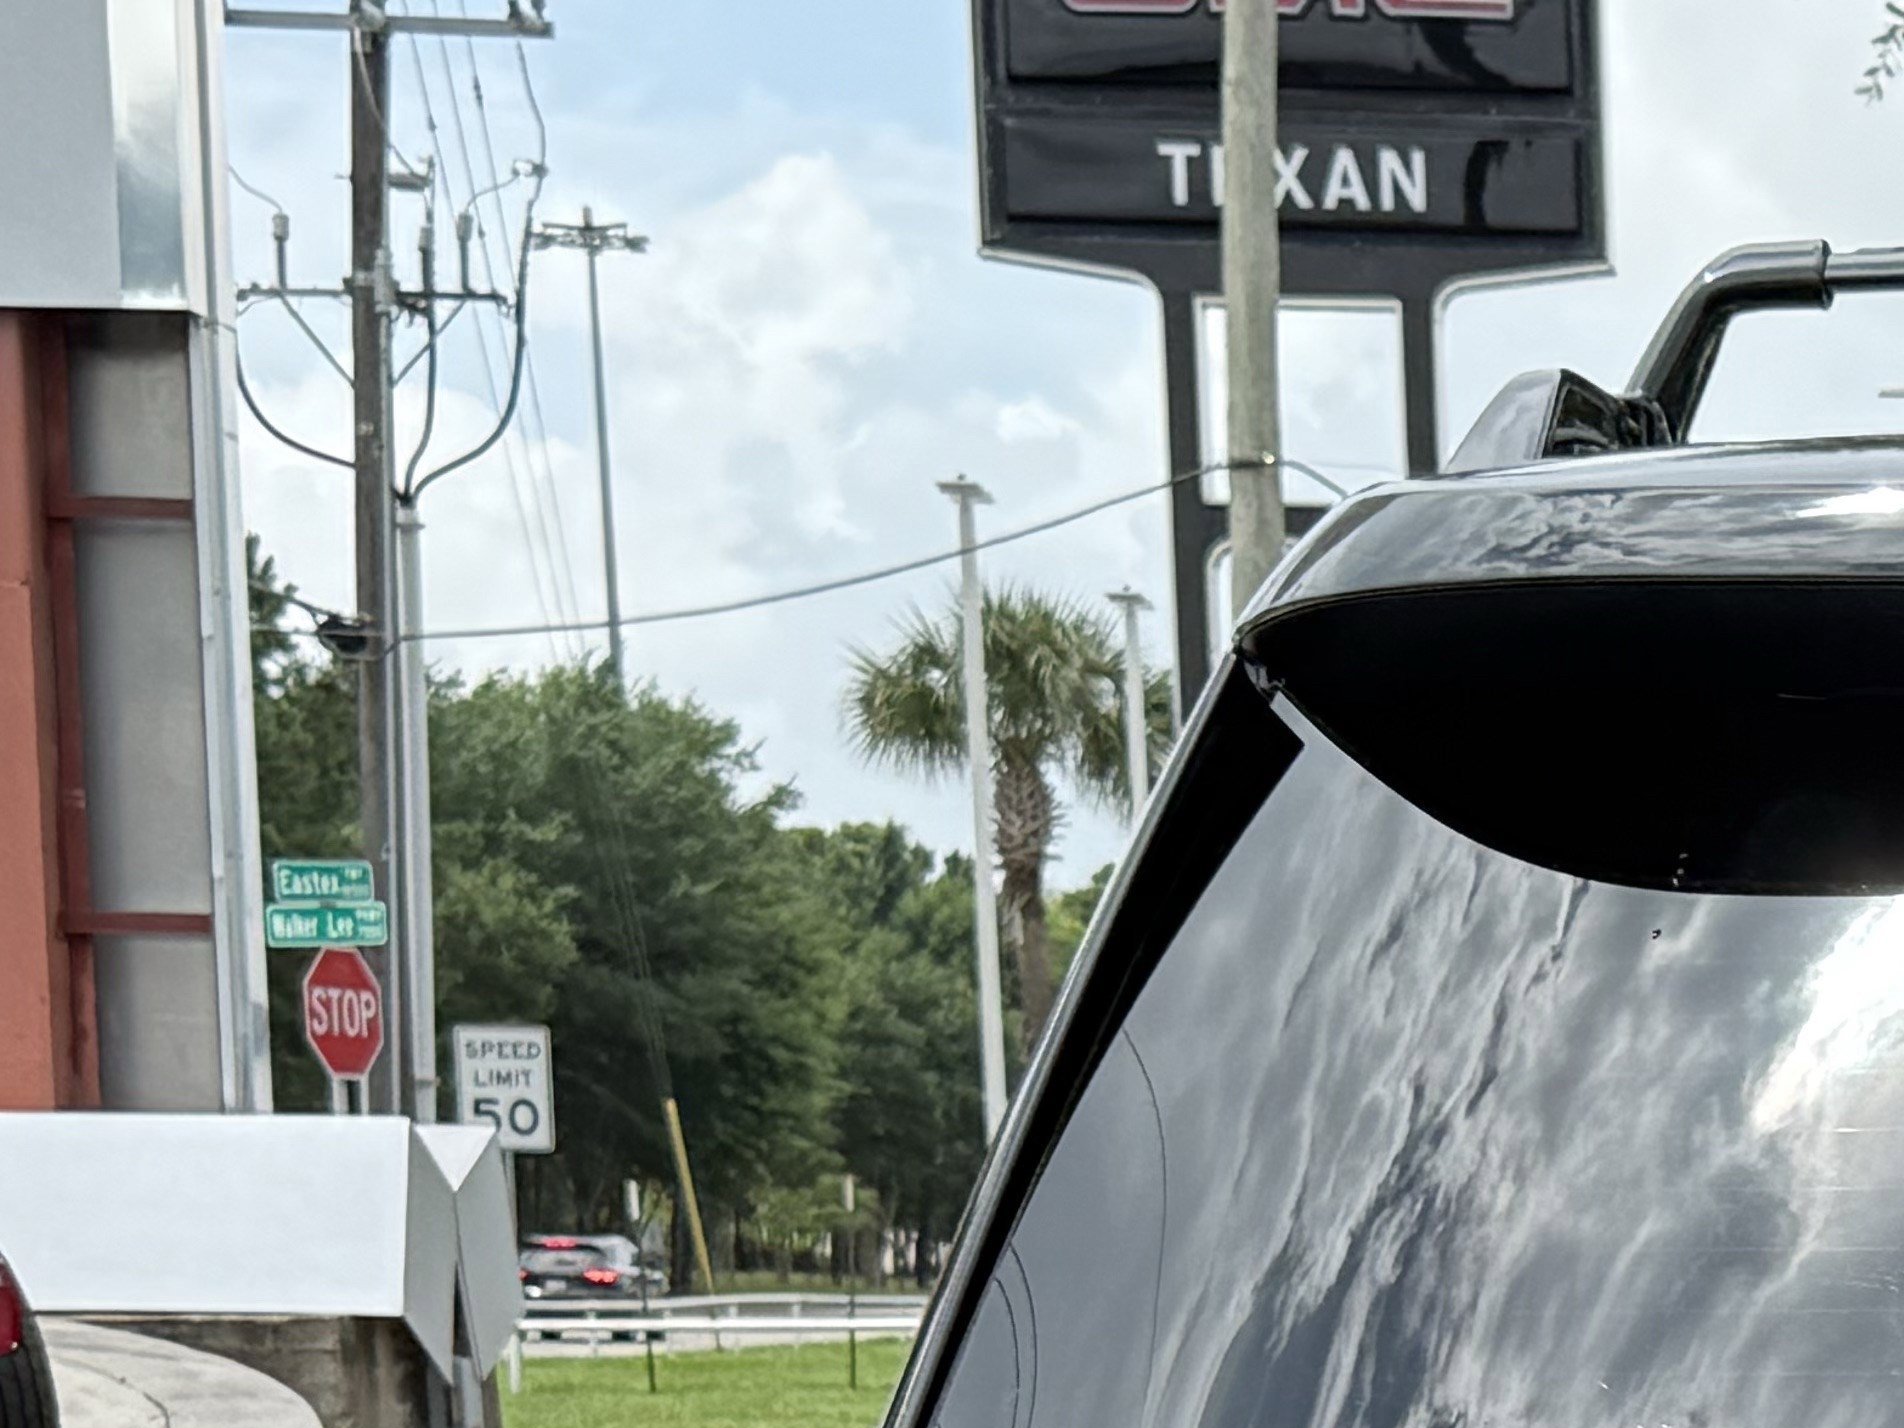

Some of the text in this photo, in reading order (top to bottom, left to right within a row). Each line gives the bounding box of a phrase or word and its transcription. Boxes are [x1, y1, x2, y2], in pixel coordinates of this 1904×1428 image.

[1157, 141, 1418, 213] TXAN
[312, 987, 376, 1038] STOP
[465, 1041, 541, 1060] SPEED
[474, 1069, 531, 1088] LIMIT
[474, 1098, 539, 1136] 50
